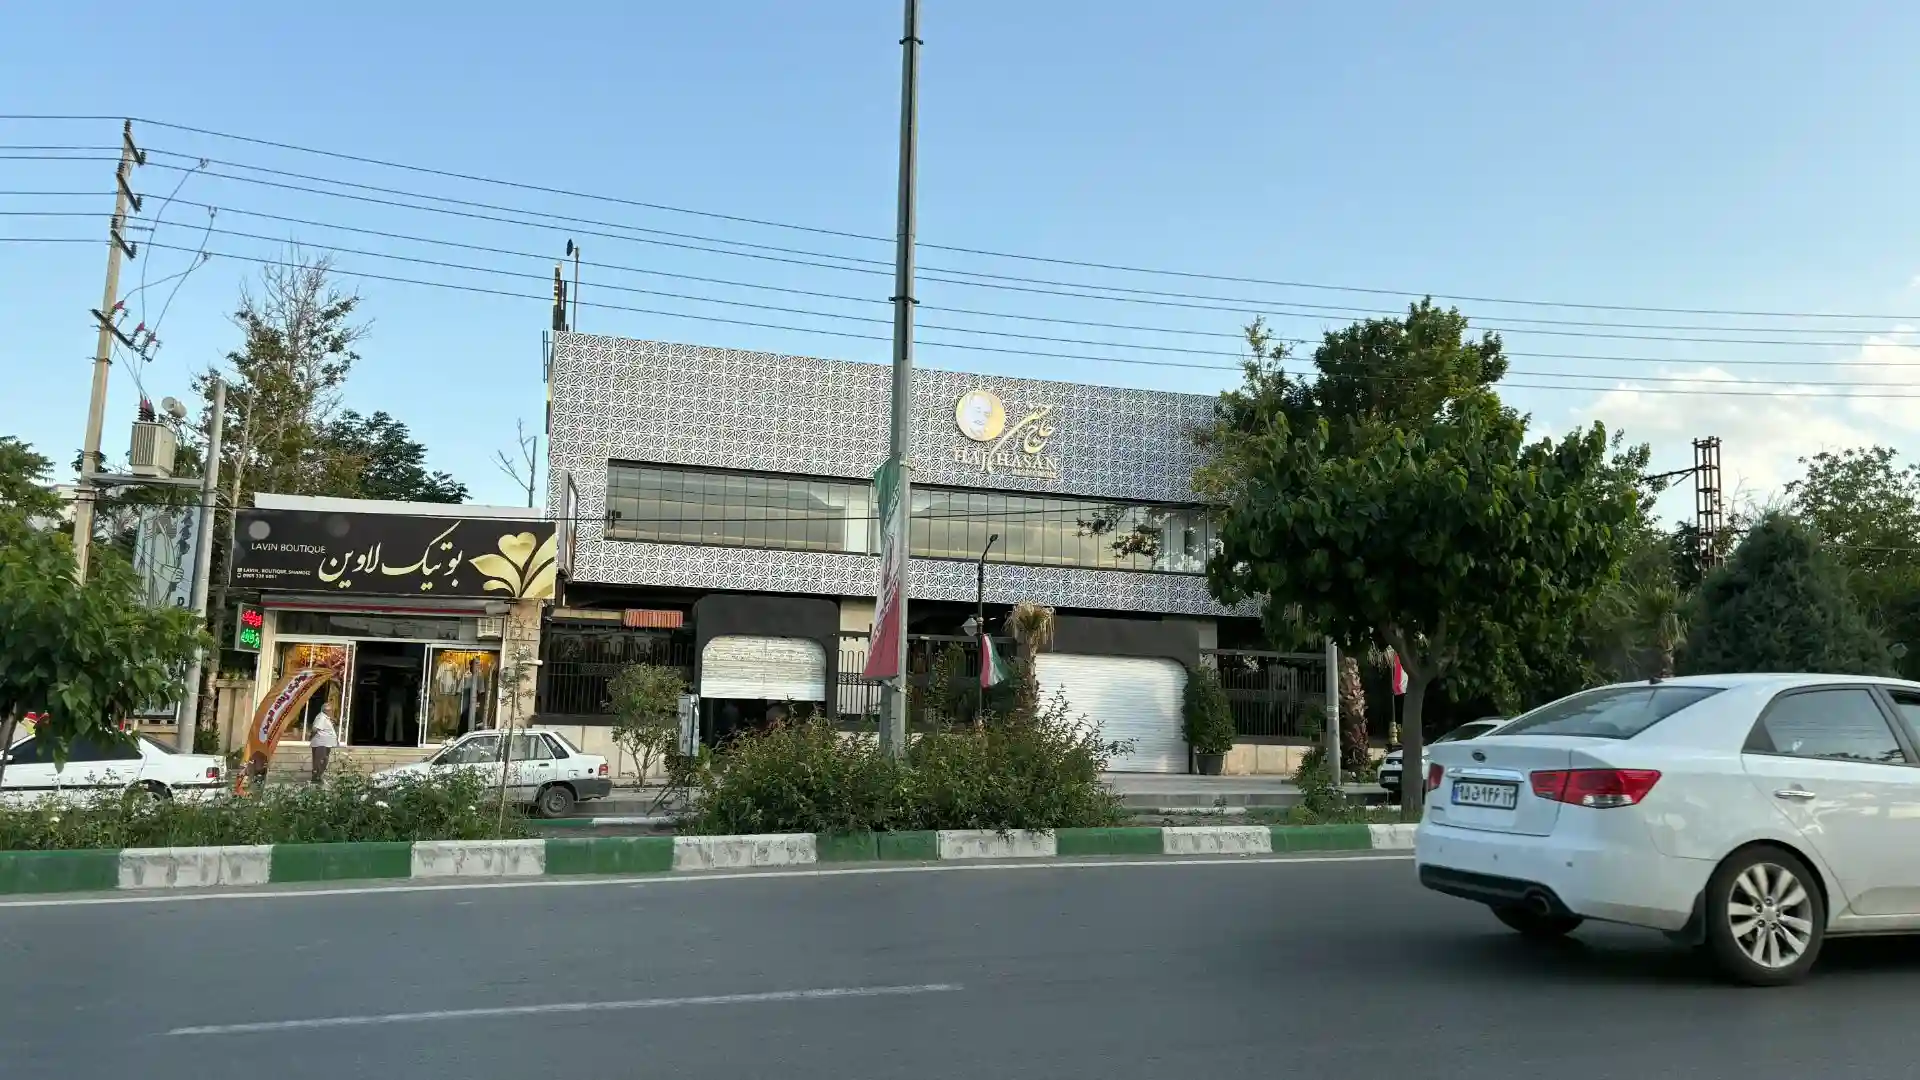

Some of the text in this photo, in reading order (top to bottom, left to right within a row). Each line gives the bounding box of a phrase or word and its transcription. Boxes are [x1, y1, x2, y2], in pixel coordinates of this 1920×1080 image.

[954, 450, 1057, 472] HAJ HASAN
[251, 542, 327, 554] LAVIN BOUTIQUE
[318, 519, 463, 591] بوتیک لاوین
